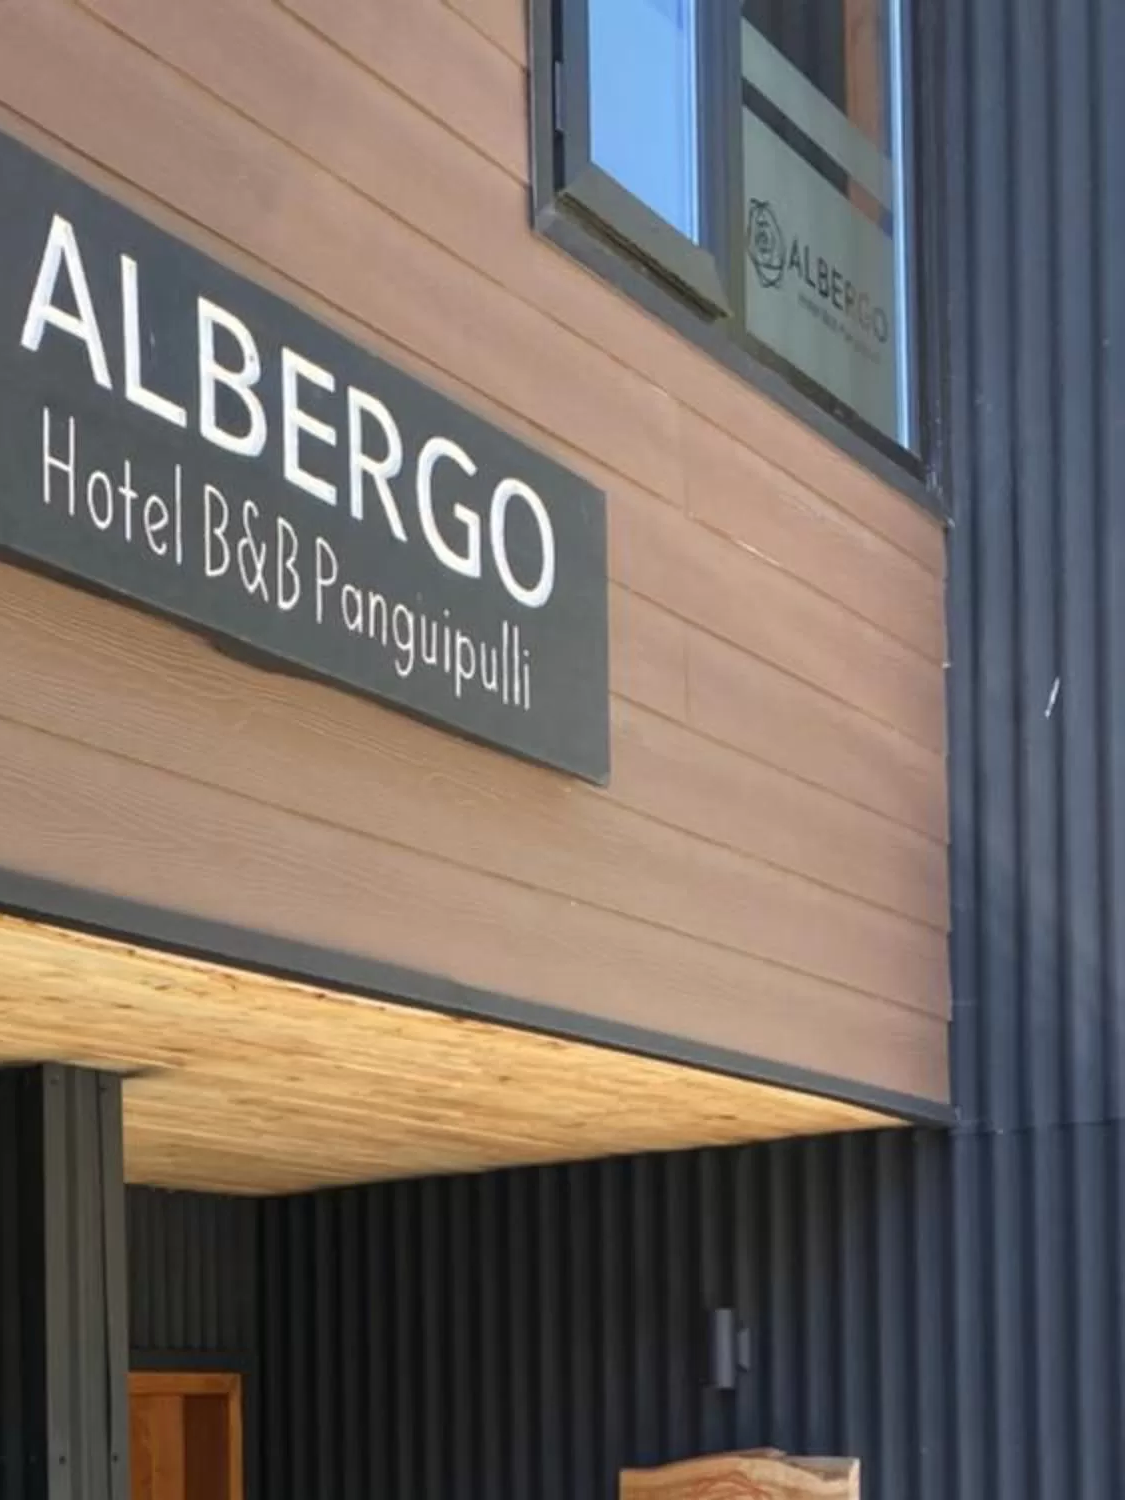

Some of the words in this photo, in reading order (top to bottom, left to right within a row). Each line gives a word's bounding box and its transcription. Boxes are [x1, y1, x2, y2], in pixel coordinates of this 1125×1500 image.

[20, 213, 556, 608] ALBERGO
[787, 239, 889, 343] ALBERGO
[42, 407, 182, 566] Hotel
[203, 484, 302, 611] B&B
[315, 537, 531, 710] Panguipulli
